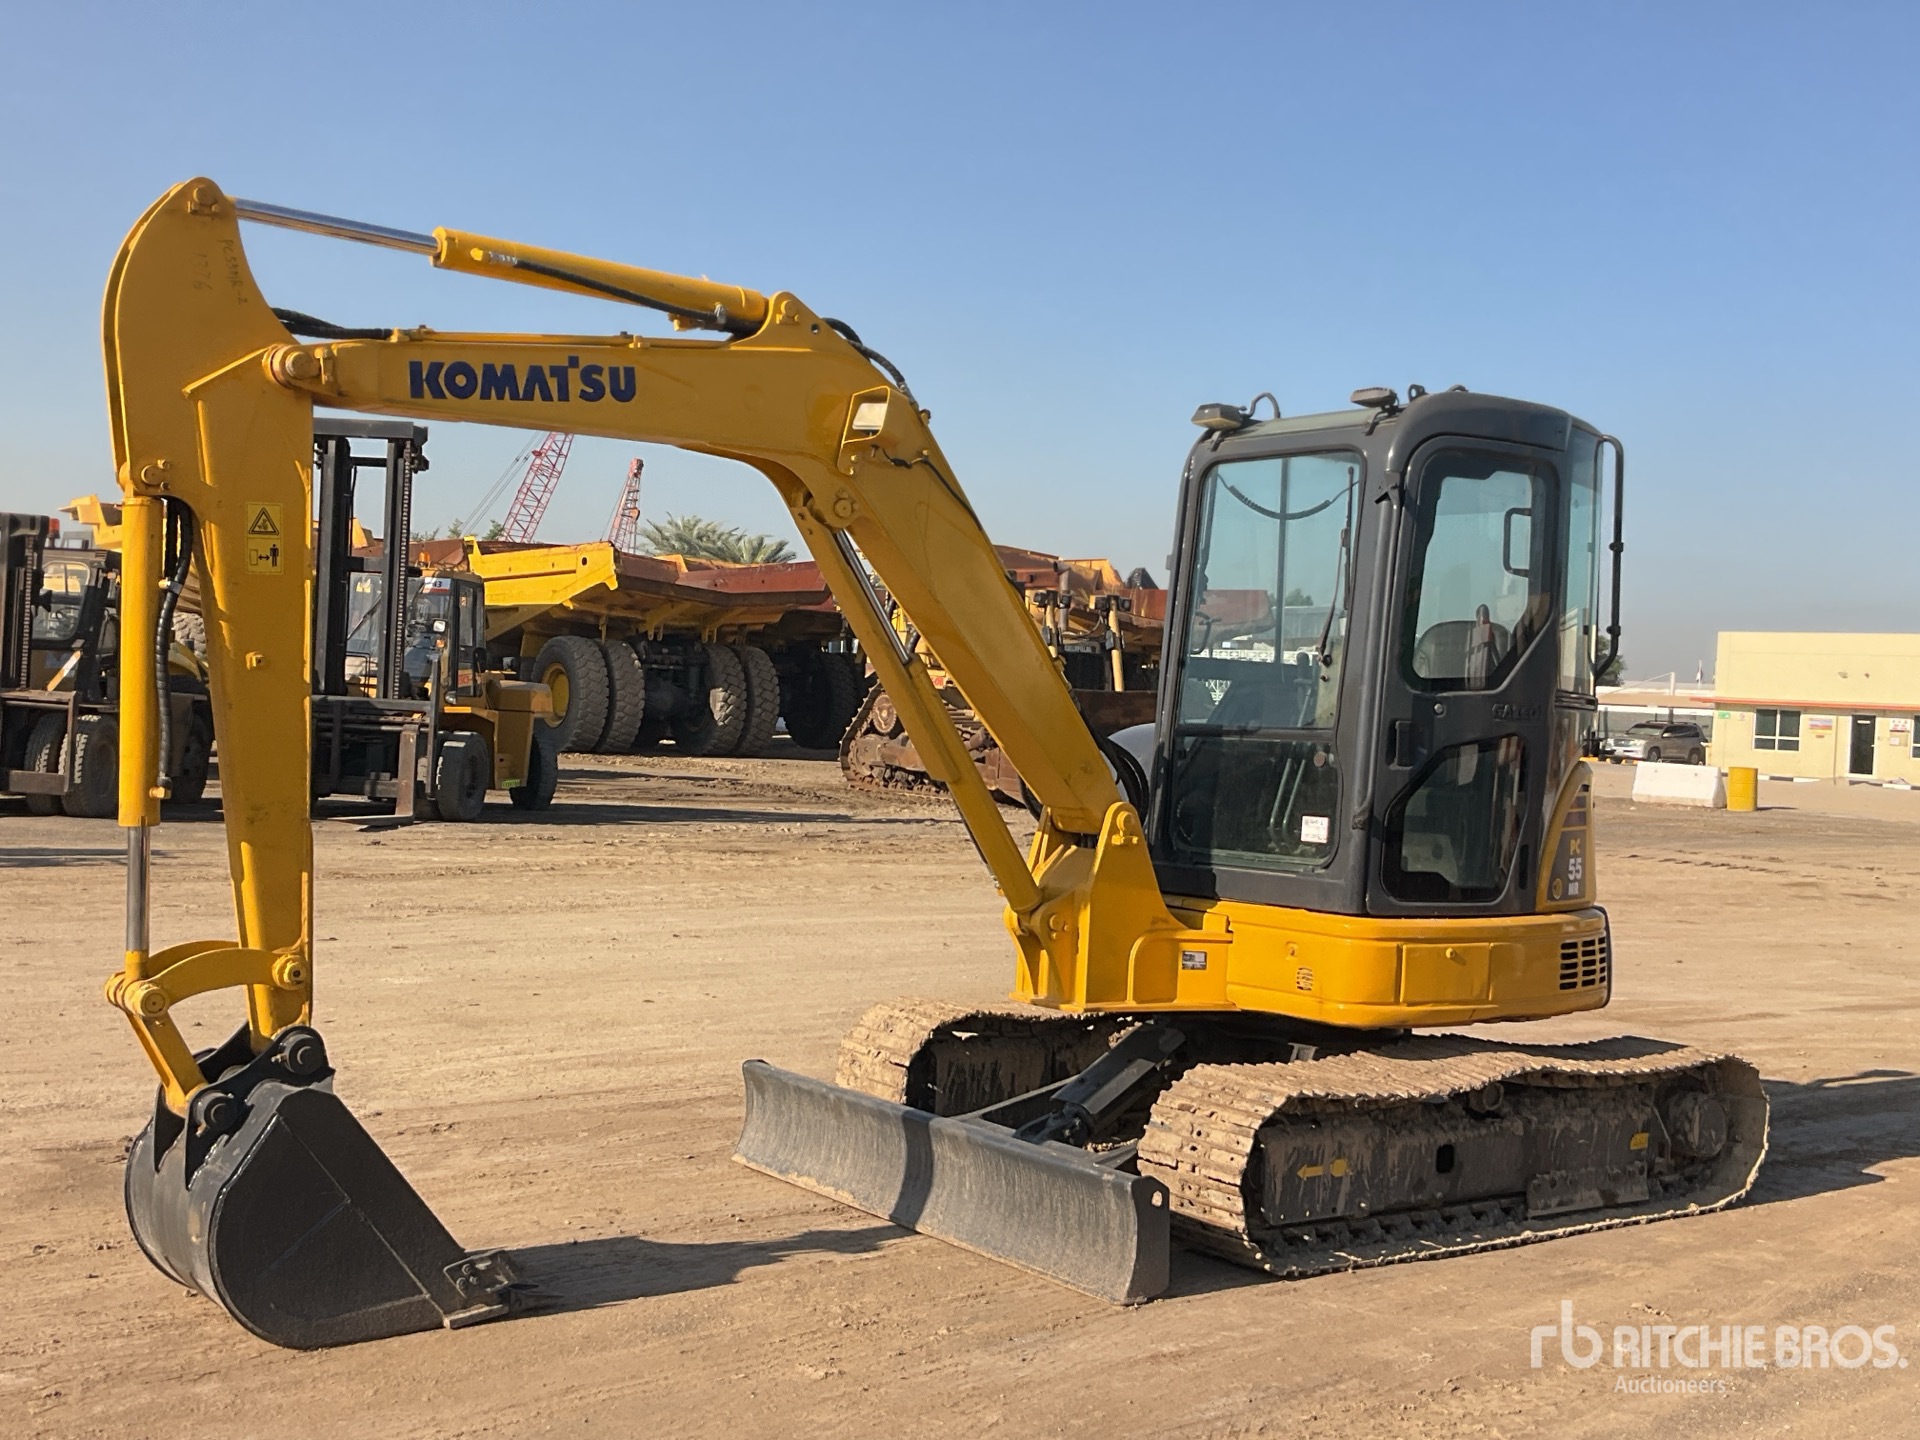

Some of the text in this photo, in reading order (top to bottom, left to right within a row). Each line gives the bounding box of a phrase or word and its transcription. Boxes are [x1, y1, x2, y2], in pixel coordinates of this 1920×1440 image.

[408, 355, 636, 402] KOMATSU
[1570, 838, 1581, 855] PC
[1568, 857, 1582, 880] 55
